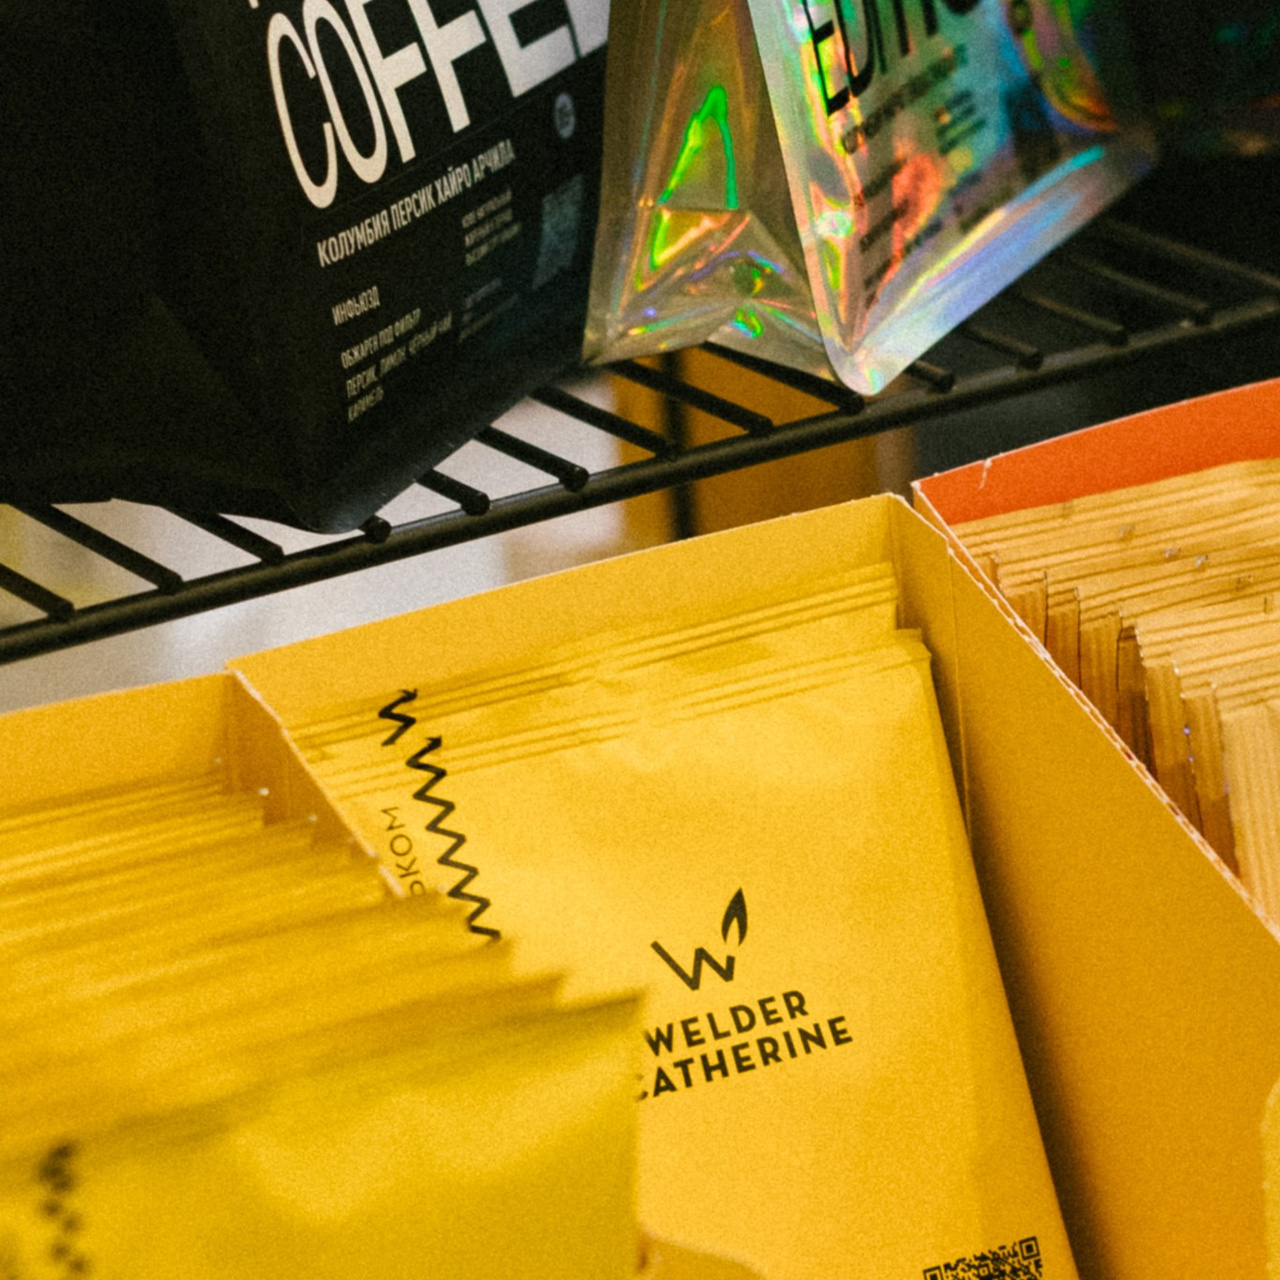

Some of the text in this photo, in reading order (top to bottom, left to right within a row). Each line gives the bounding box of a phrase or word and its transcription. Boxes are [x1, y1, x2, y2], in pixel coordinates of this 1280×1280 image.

[316, 209, 391, 268] КОЛУМБИЯ
[390, 183, 437, 231] ПЕРСИК
[434, 163, 472, 206] ХАЙРО
[637, 1015, 854, 1101] ATHERINE
[644, 989, 810, 1057] WELDER
